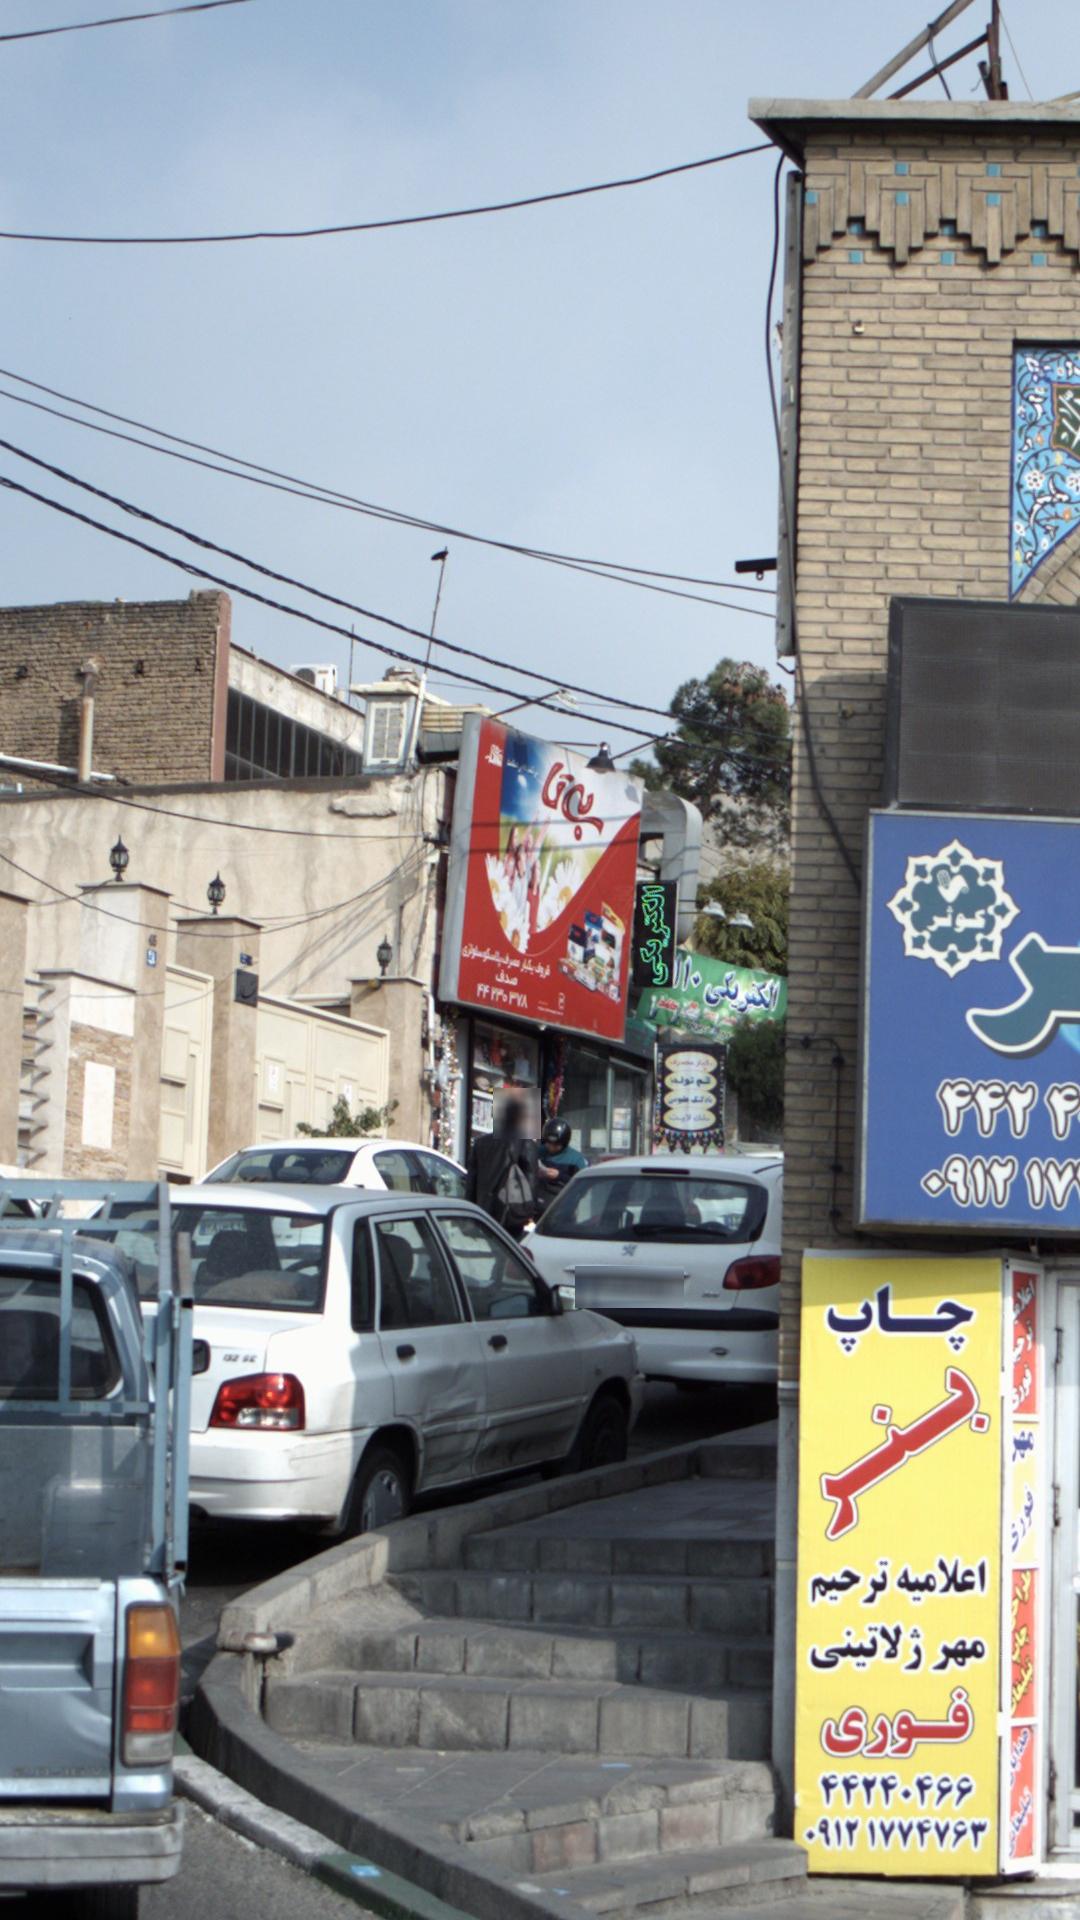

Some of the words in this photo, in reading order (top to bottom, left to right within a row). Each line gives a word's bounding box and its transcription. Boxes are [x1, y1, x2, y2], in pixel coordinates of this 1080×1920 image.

[928, 905, 987, 934] کوثر
[938, 1079, 1037, 1138] ۴۴۲
[921, 1155, 1017, 1208] ۰۹۱۲
[1025, 1158, 1080, 1210] ۱۷
[827, 1283, 975, 1354] چاپ
[820, 1366, 990, 1541] بنر
[812, 1560, 888, 1604] ترحیم
[897, 1558, 985, 1602] اعلامیه
[811, 1624, 922, 1670] ژلاتینی
[932, 1638, 985, 1670] مهر
[822, 1688, 973, 1756] فوری
[821, 1774, 974, 1807] ۴۴۲۴۰۴۶۶
[806, 1818, 858, 1847] ۰۹۱۲
[868, 1819, 988, 1849] ۱۷۷۴۷۶۳
